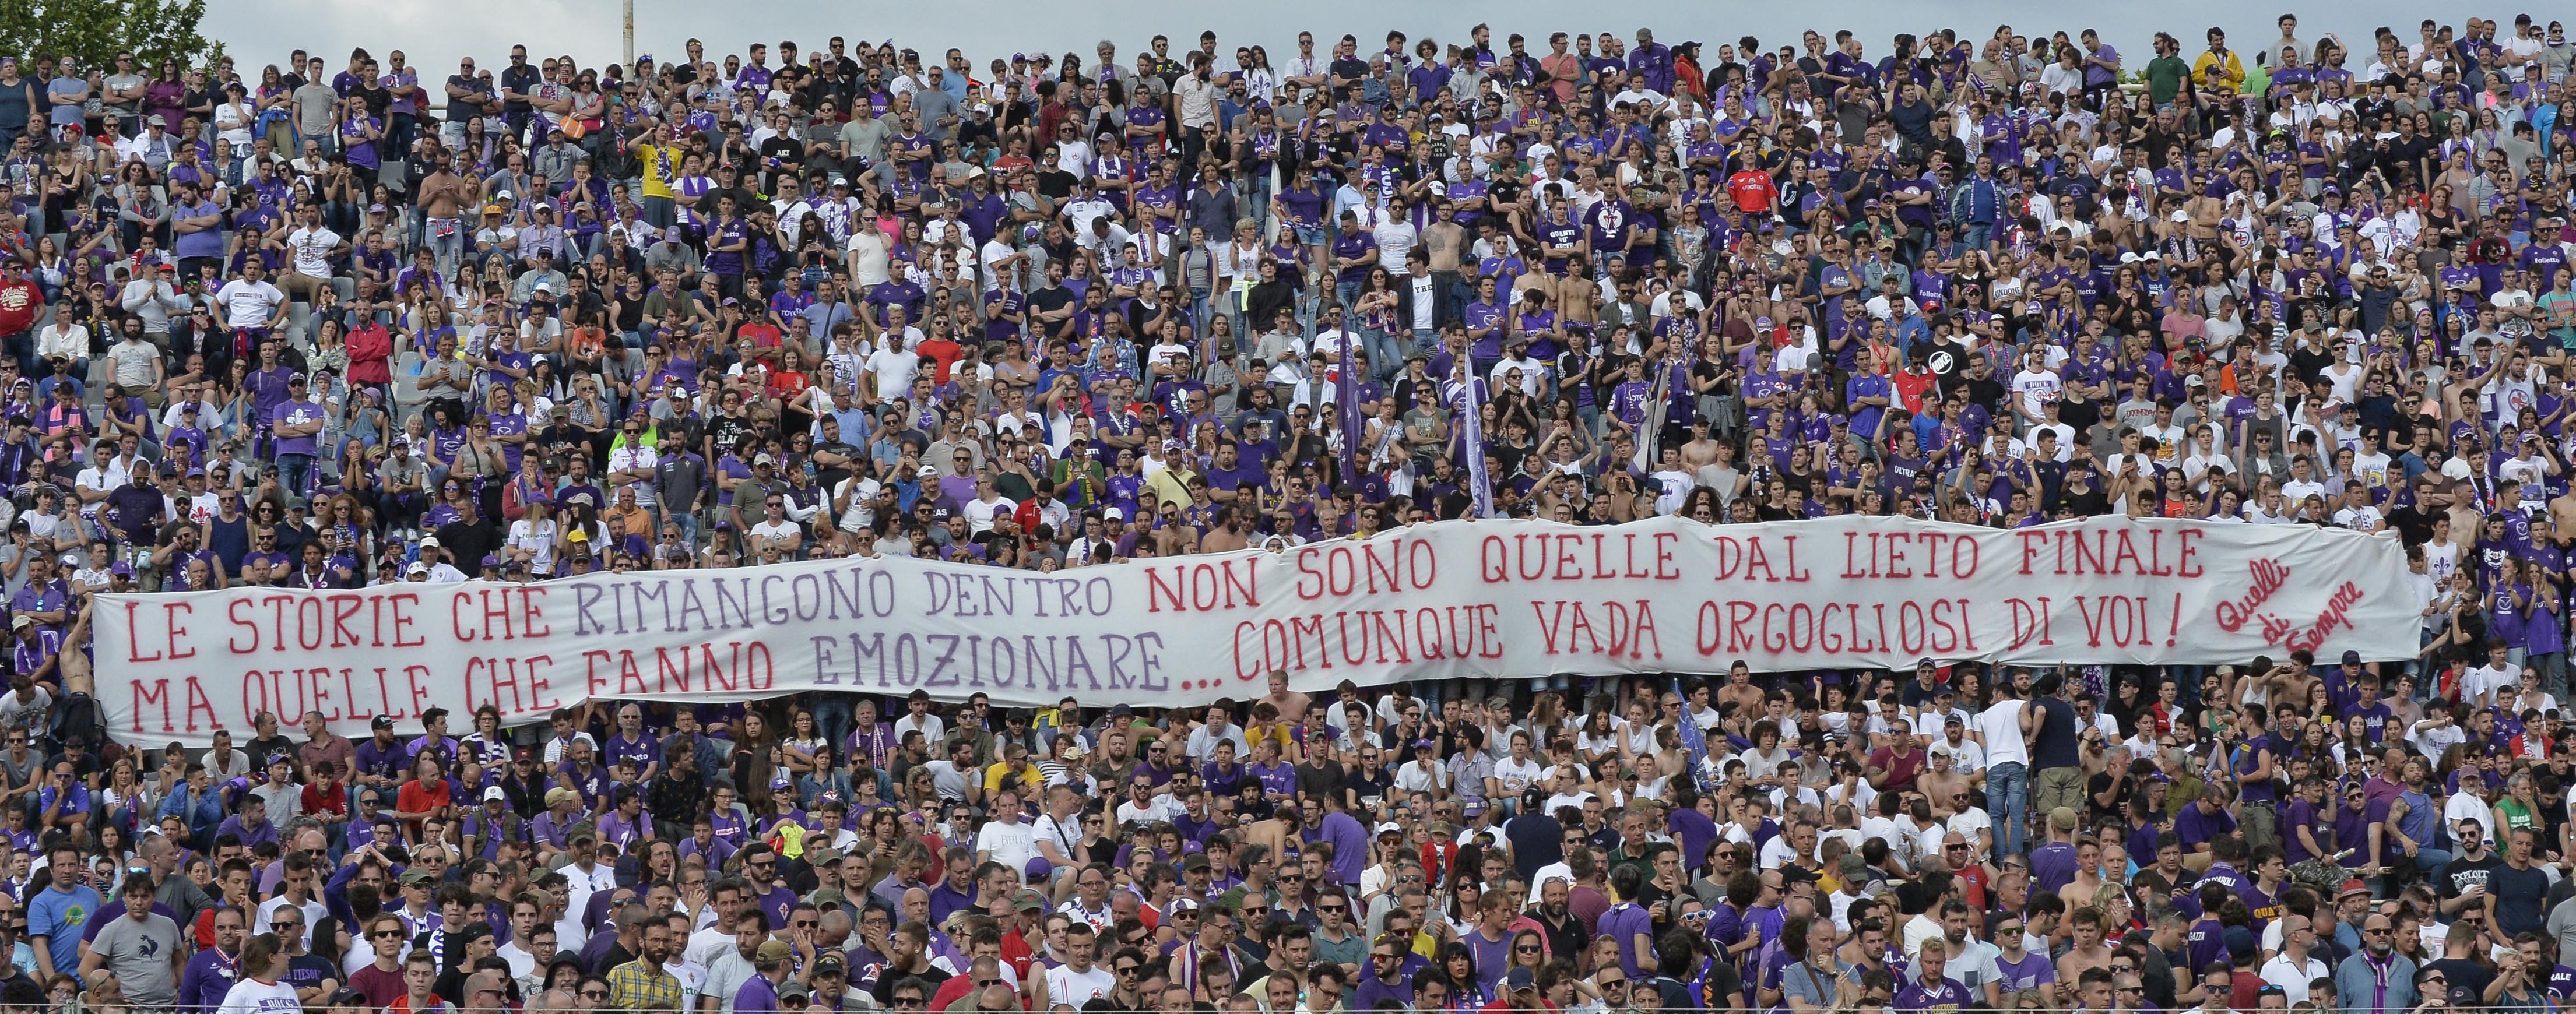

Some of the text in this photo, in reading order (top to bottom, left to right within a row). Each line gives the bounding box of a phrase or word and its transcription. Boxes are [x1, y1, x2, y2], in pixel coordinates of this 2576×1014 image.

[1550, 230, 1575, 238] QUANTI
[1931, 353, 1951, 372] NIKE
[125, 529, 2204, 663] LE STORIE CHE RIMANGONO DENTRO NON SONO QUELLE DAL LIETO FINALE
[2216, 558, 2291, 633] Quelli
[2259, 612, 2291, 646] di
[130, 676, 223, 733] MA
[243, 665, 437, 728] QUELLE
[466, 654, 560, 717] CHE
[582, 642, 774, 695] FANNO
[1233, 604, 1503, 681] COMUNQUE
[1531, 599, 1663, 659] VADA
[1697, 598, 1978, 656] ORGOGLIOSI
[2004, 596, 2054, 652] DI
[2188, 931, 2205, 941] GAZZA
